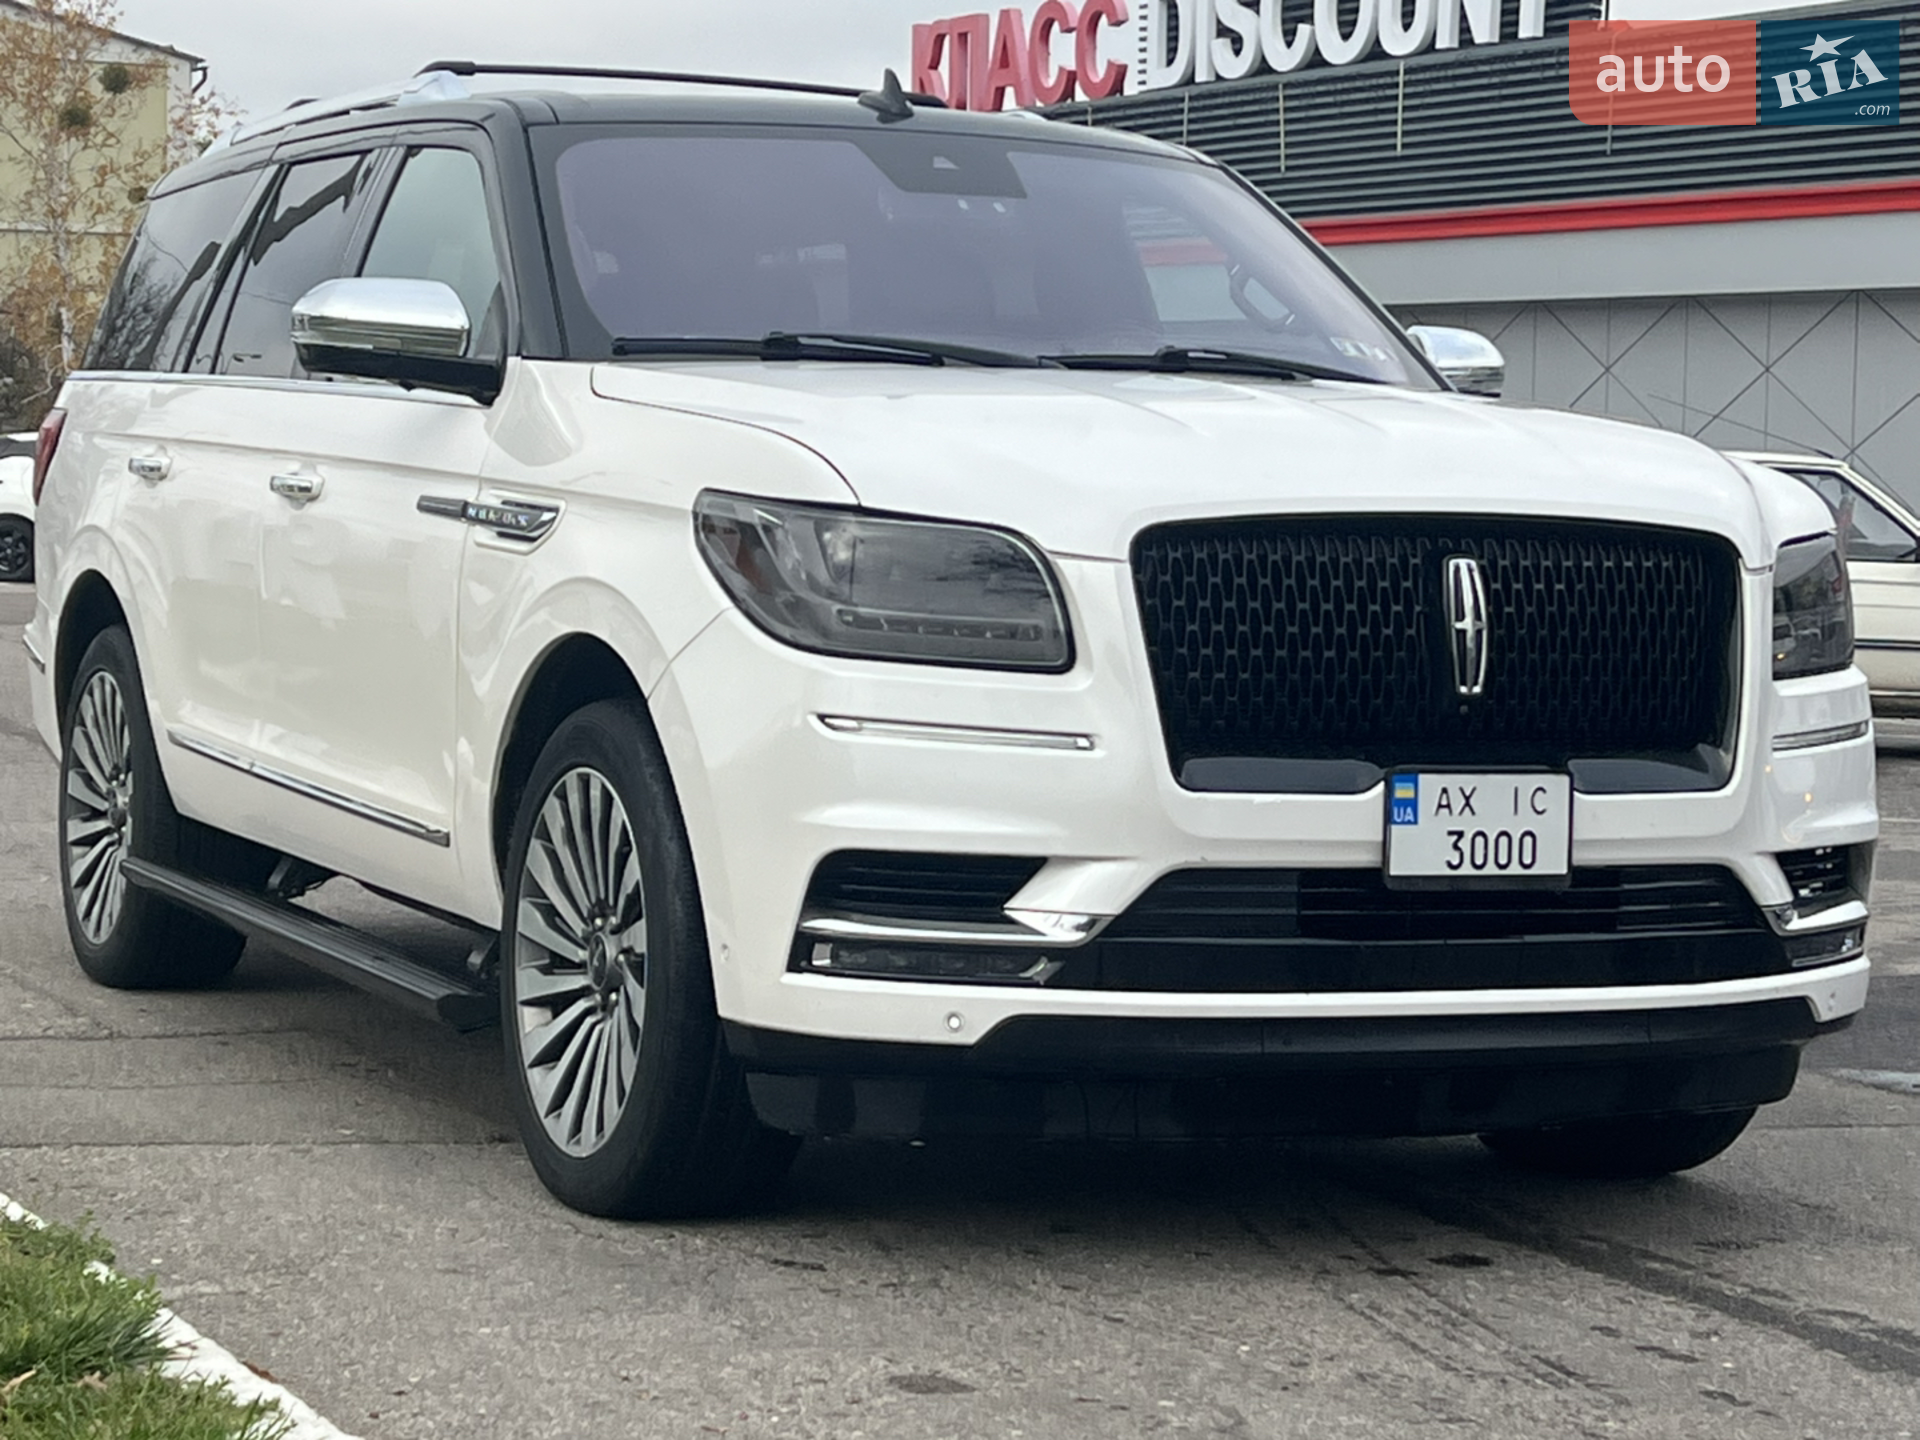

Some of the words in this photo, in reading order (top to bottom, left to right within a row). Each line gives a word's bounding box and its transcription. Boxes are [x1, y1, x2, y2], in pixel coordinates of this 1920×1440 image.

[1393, 806, 1415, 822] UA
[1434, 786, 1477, 816] AX
[1513, 786, 1547, 816] IC
[1446, 830, 1537, 870] 3000
